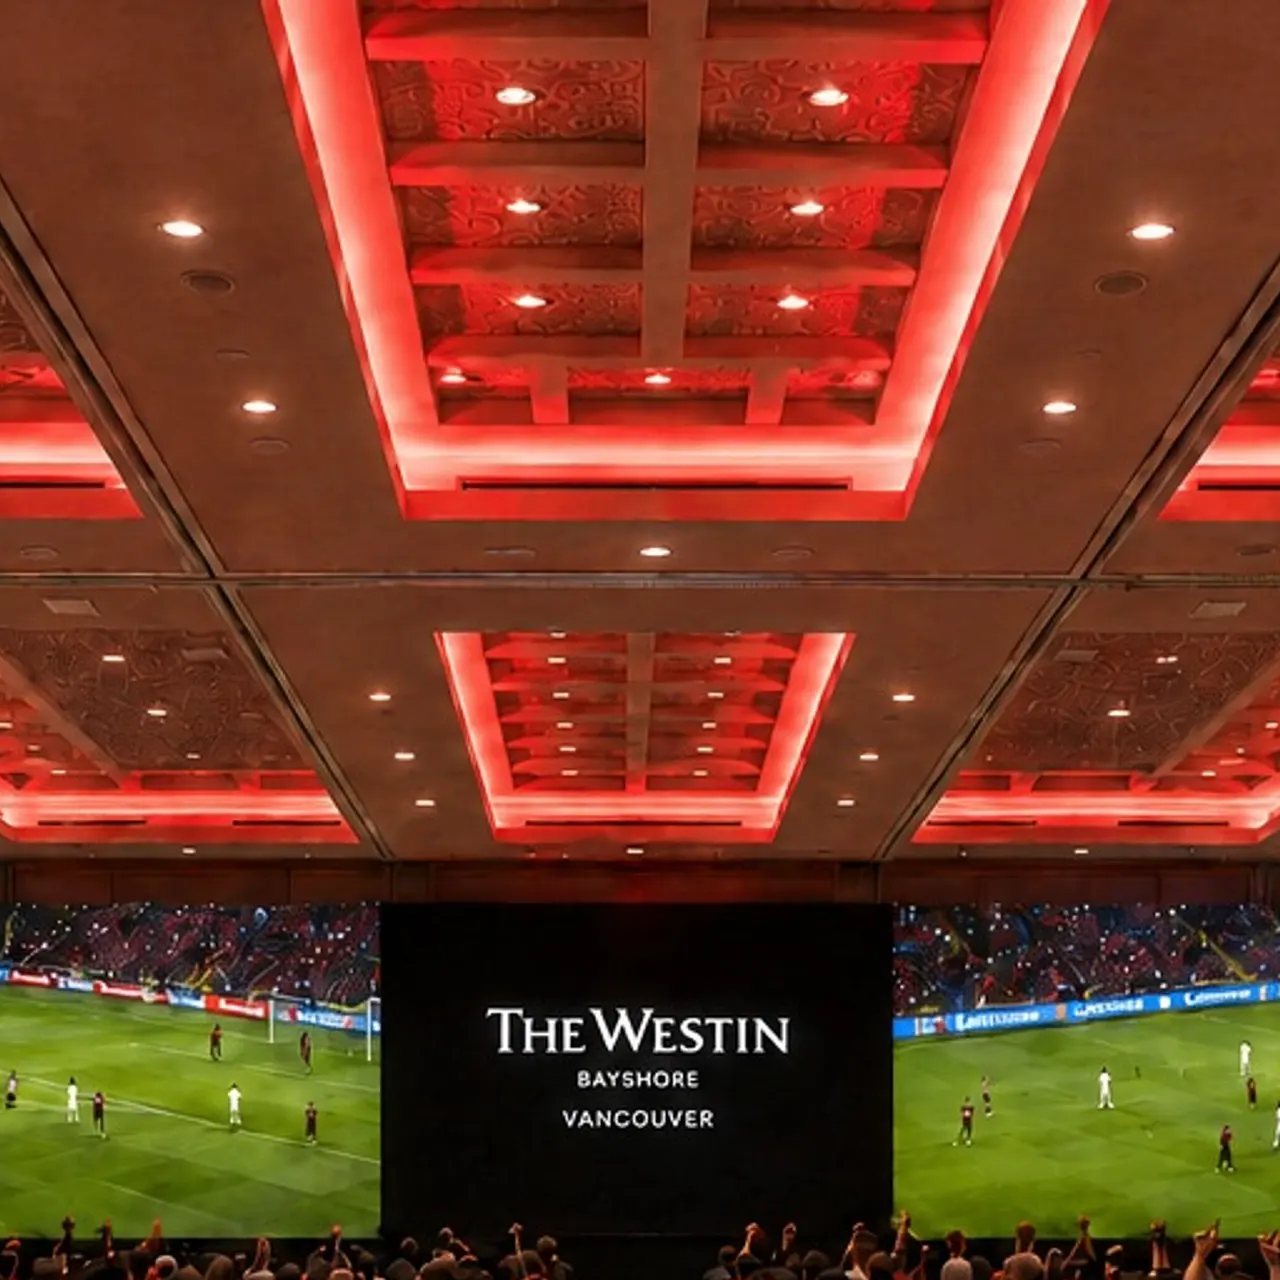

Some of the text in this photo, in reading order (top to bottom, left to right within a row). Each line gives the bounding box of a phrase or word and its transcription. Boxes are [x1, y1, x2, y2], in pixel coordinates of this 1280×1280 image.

[486, 1008, 790, 1054] THE WESTIN
[577, 1070, 699, 1089] BAYSHORE
[562, 1109, 714, 1129] VANCOUVER
